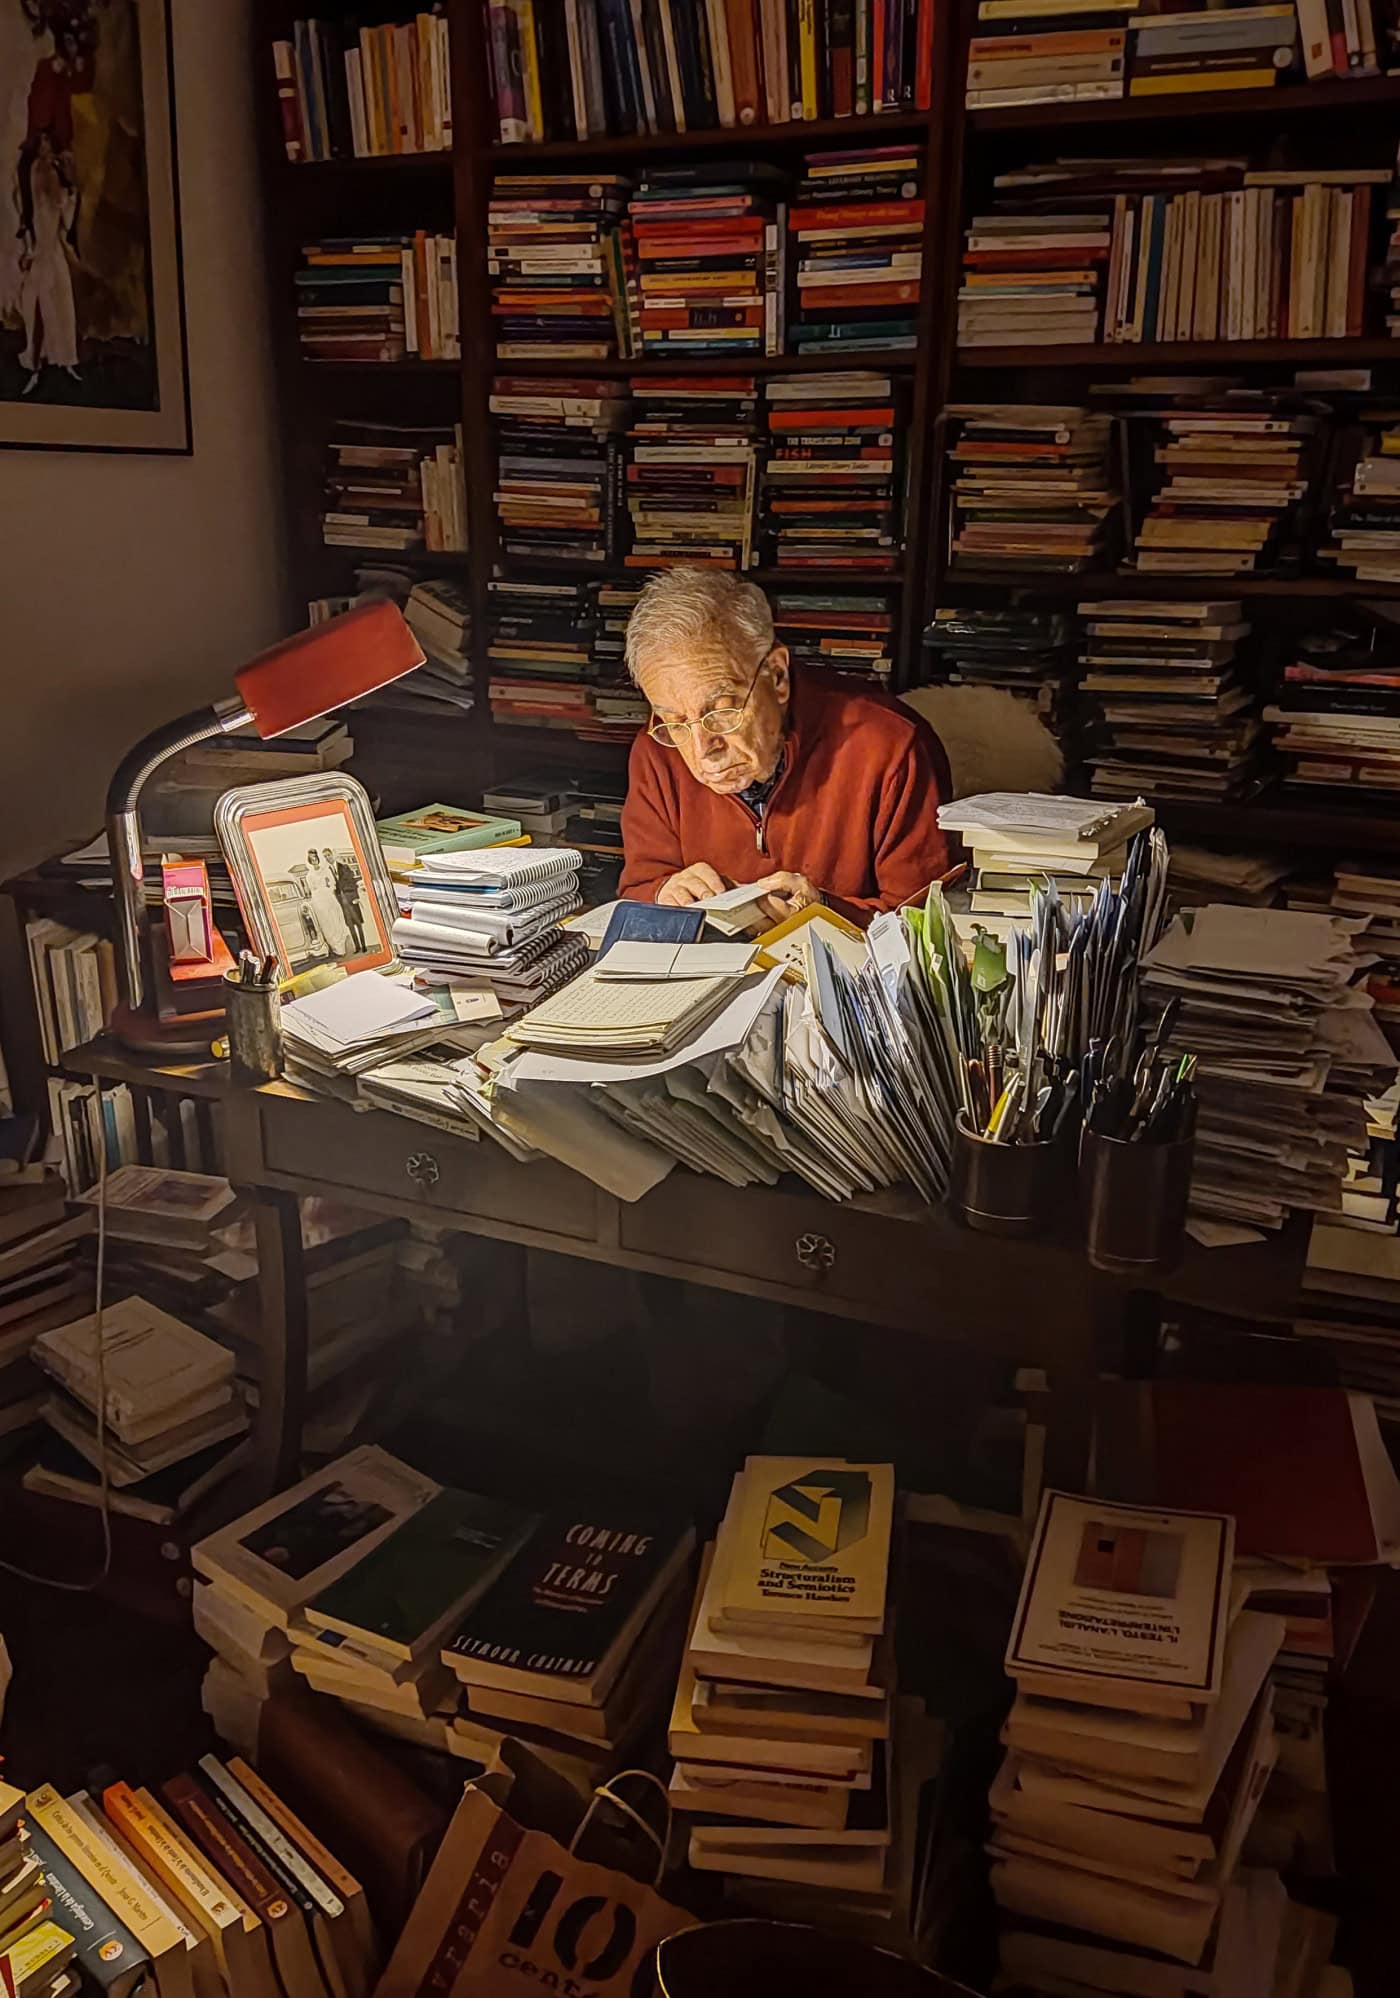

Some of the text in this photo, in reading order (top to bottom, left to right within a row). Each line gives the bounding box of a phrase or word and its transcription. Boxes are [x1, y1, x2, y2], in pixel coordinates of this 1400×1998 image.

[775, 447, 812, 460] FISH
[566, 1523, 654, 1556] COMING
[542, 1562, 618, 1594] TERMS
[757, 1580, 857, 1593] and Semiotics
[760, 1568, 856, 1584] Structuralism
[507, 1868, 638, 1982] 10
[498, 1952, 600, 1998] cent
